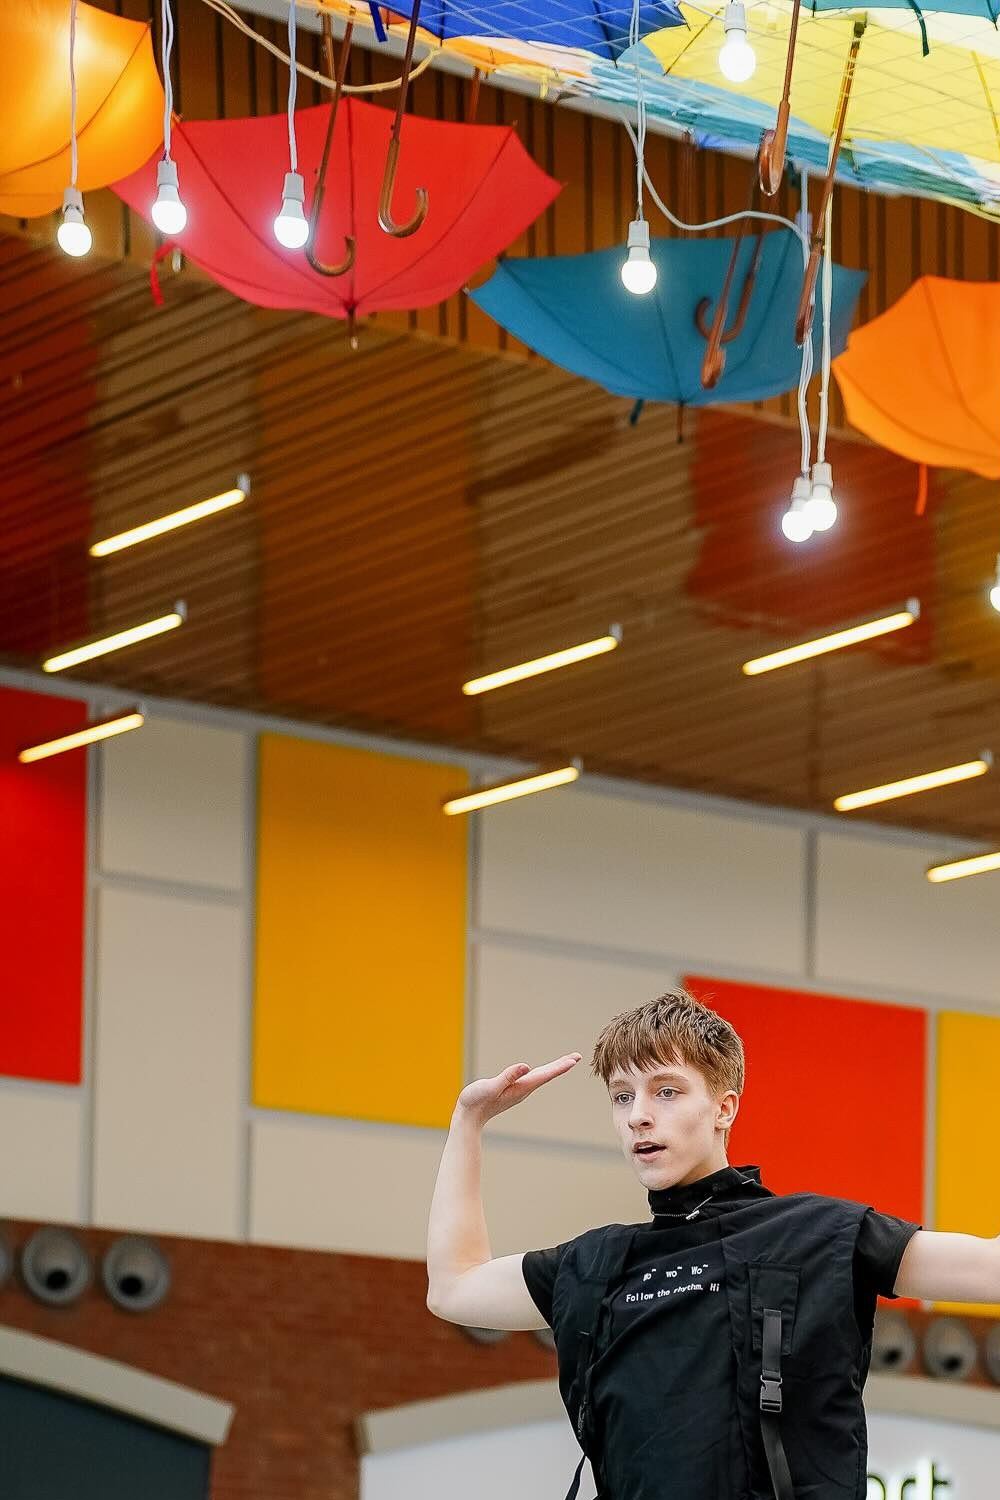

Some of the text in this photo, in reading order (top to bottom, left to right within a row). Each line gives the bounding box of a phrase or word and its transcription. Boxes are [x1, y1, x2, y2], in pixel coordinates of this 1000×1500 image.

[626, 1292, 654, 1303] Follow
[657, 1289, 671, 1298] the
[709, 1282, 720, 1292] Hi
